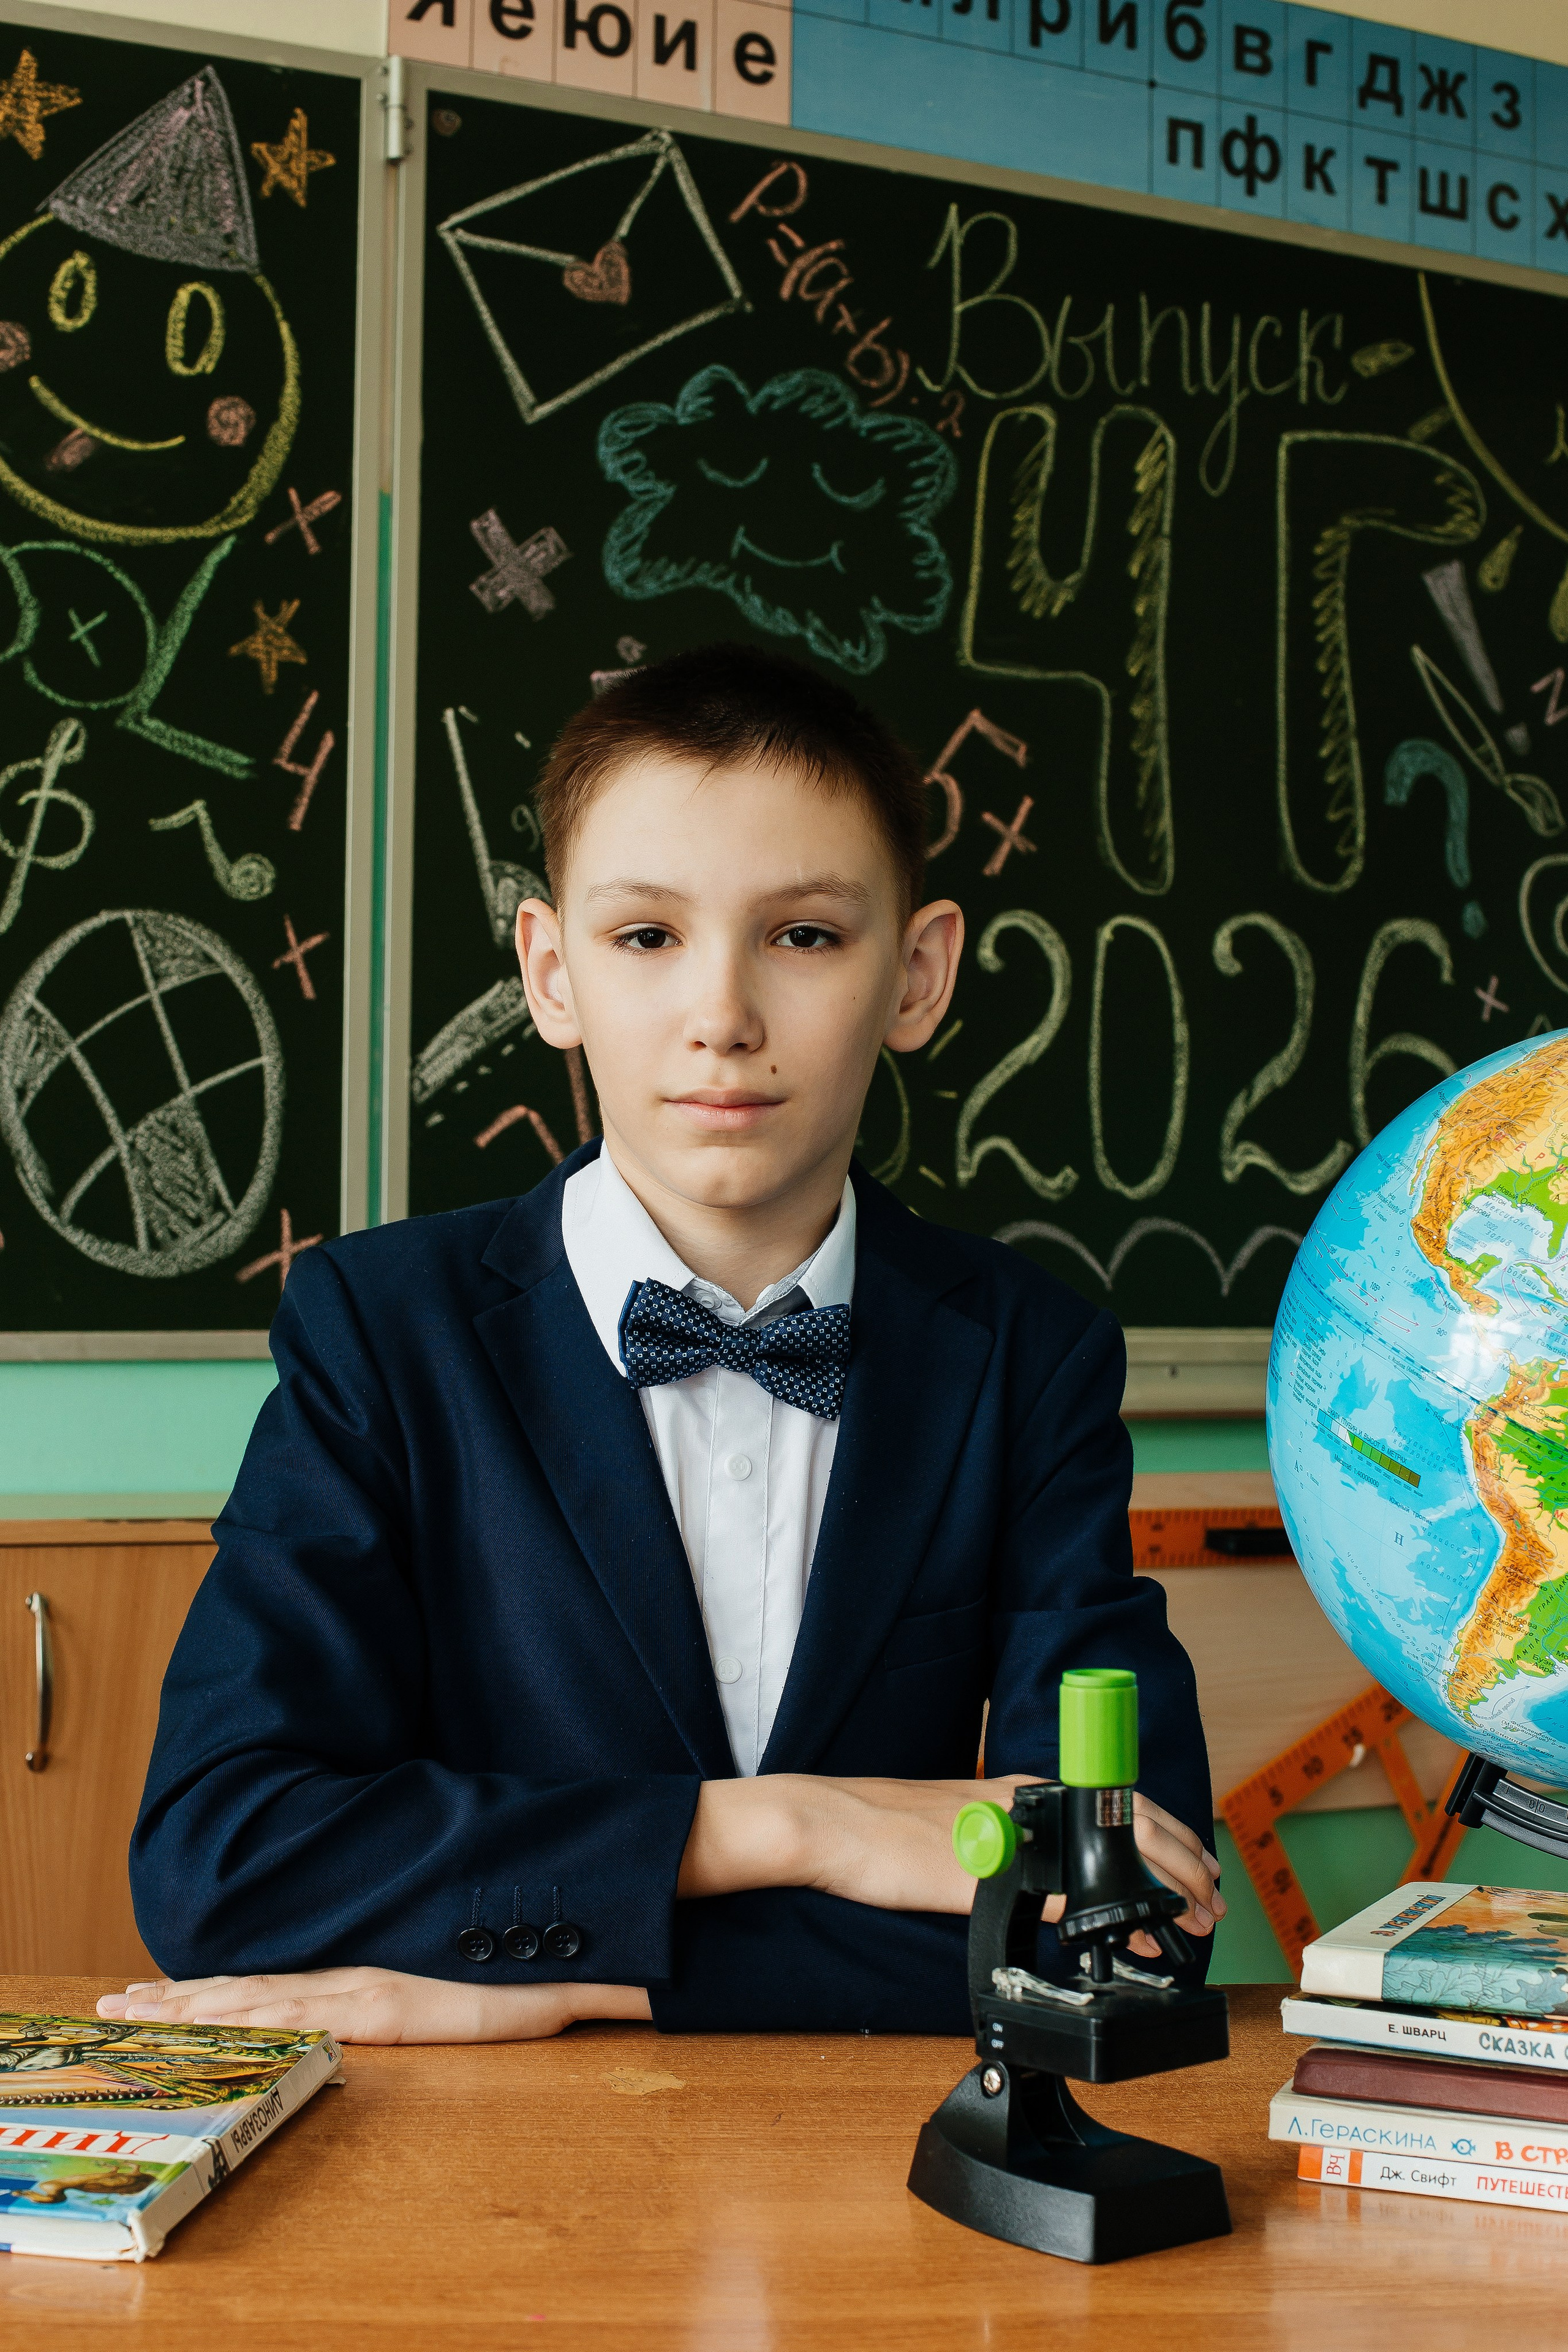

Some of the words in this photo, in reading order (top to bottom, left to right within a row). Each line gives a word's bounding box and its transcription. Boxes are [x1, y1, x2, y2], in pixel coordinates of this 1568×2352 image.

[916, 203, 1349, 497] Выпуск
[956, 909, 1459, 1202] 2026
[1456, 1194, 1491, 1218] Монтеррей
[1479, 1188, 1507, 1207] Хьюстон
[1497, 1184, 1518, 1200] Новый
[1520, 1197, 1548, 1216] Орлеан
[1482, 1201, 1547, 1239] Мексиканский
[1485, 1230, 1512, 1247] залив
[1507, 1265, 1541, 1295] Большие
[1363, 1431, 1381, 1447] ВЫСОТ
[1387, 1448, 1408, 1464] МЕТРАХ
[1391, 1426, 1447, 1464] Перуанская
[1389, 1495, 1410, 1513] Южный
[1412, 1510, 1433, 1526] тропик
[1420, 1560, 1476, 1593] котловина
[1474, 1618, 1514, 1642] Сантьяго
[1495, 1616, 1534, 1637] Аконкагуа
[1502, 1609, 1538, 1630] Кордова
[1420, 1657, 1442, 1673] Тайтао
[1509, 1637, 1540, 1665] ПАМПА
[1532, 1654, 1567, 1672] Буэнос-
[1464, 1665, 1498, 1702] ПАТАГОНИЯ
[1482, 1730, 1501, 1742] Горн
[1489, 1727, 1528, 1748] Огненная
[1387, 2023, 1399, 2034] Е.
[1402, 2026, 1447, 2041] ШВАРЦ
[1479, 2031, 1555, 2060] СКАЗКА
[230, 2086, 285, 2155] ДИНОЗАВРЫ
[1494, 2141, 1514, 2160] В
[1521, 2144, 1568, 2166] СТР
[1380, 2166, 1405, 2180] Дж.
[1411, 2169, 1458, 2188] Свифт
